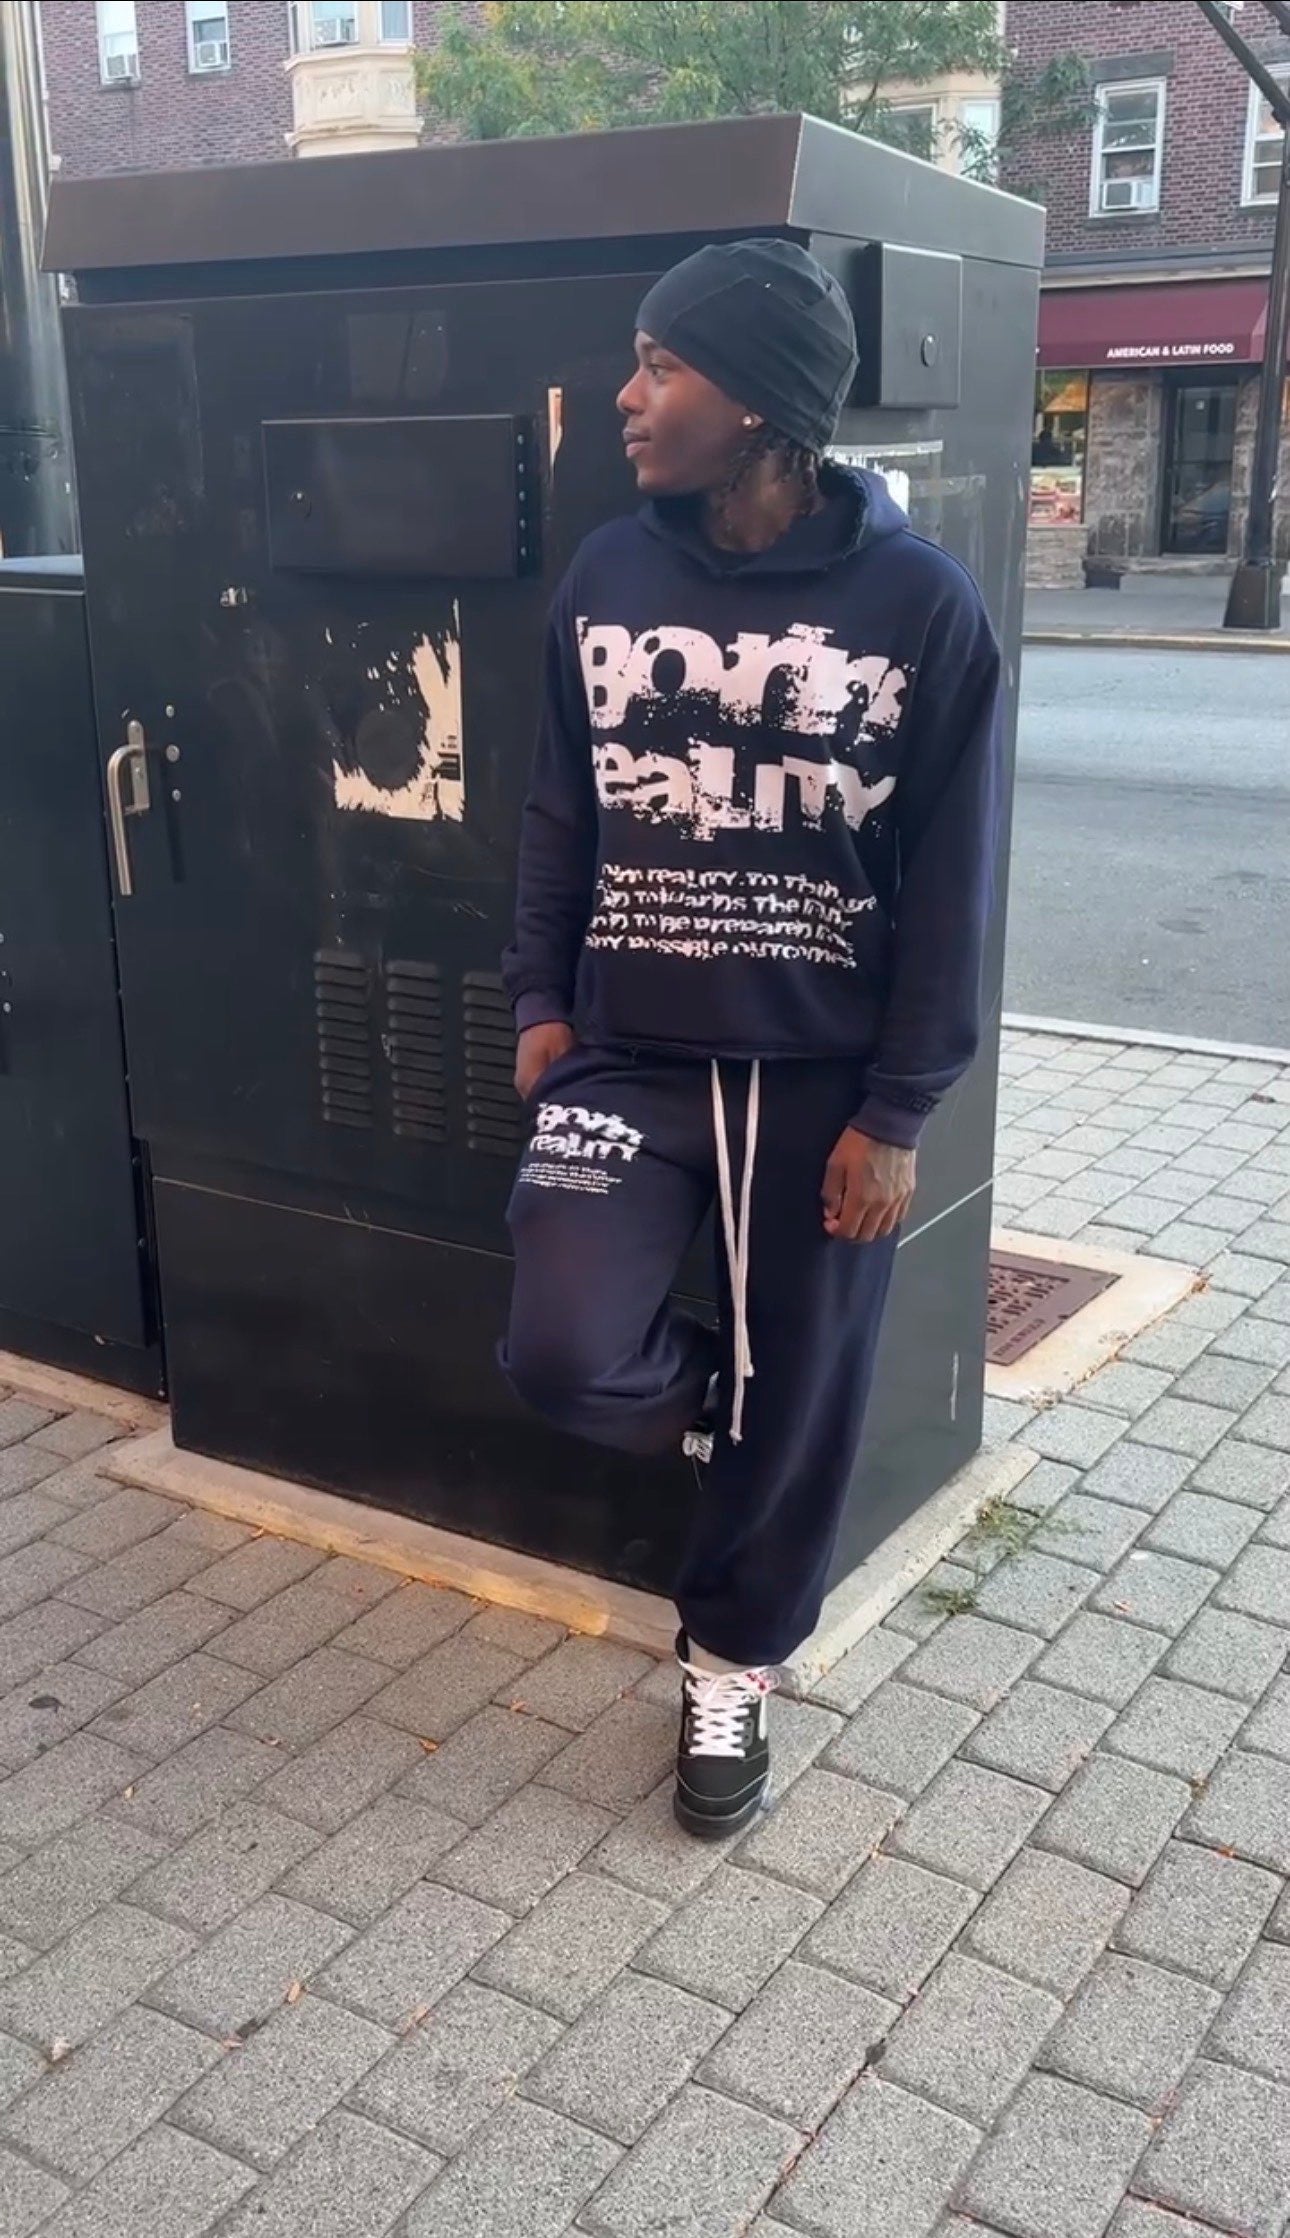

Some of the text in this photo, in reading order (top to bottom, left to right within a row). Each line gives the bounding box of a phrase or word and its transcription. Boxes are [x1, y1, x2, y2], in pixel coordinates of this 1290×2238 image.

[1106, 343, 1235, 358] AMERICAN & LATIN FOOD
